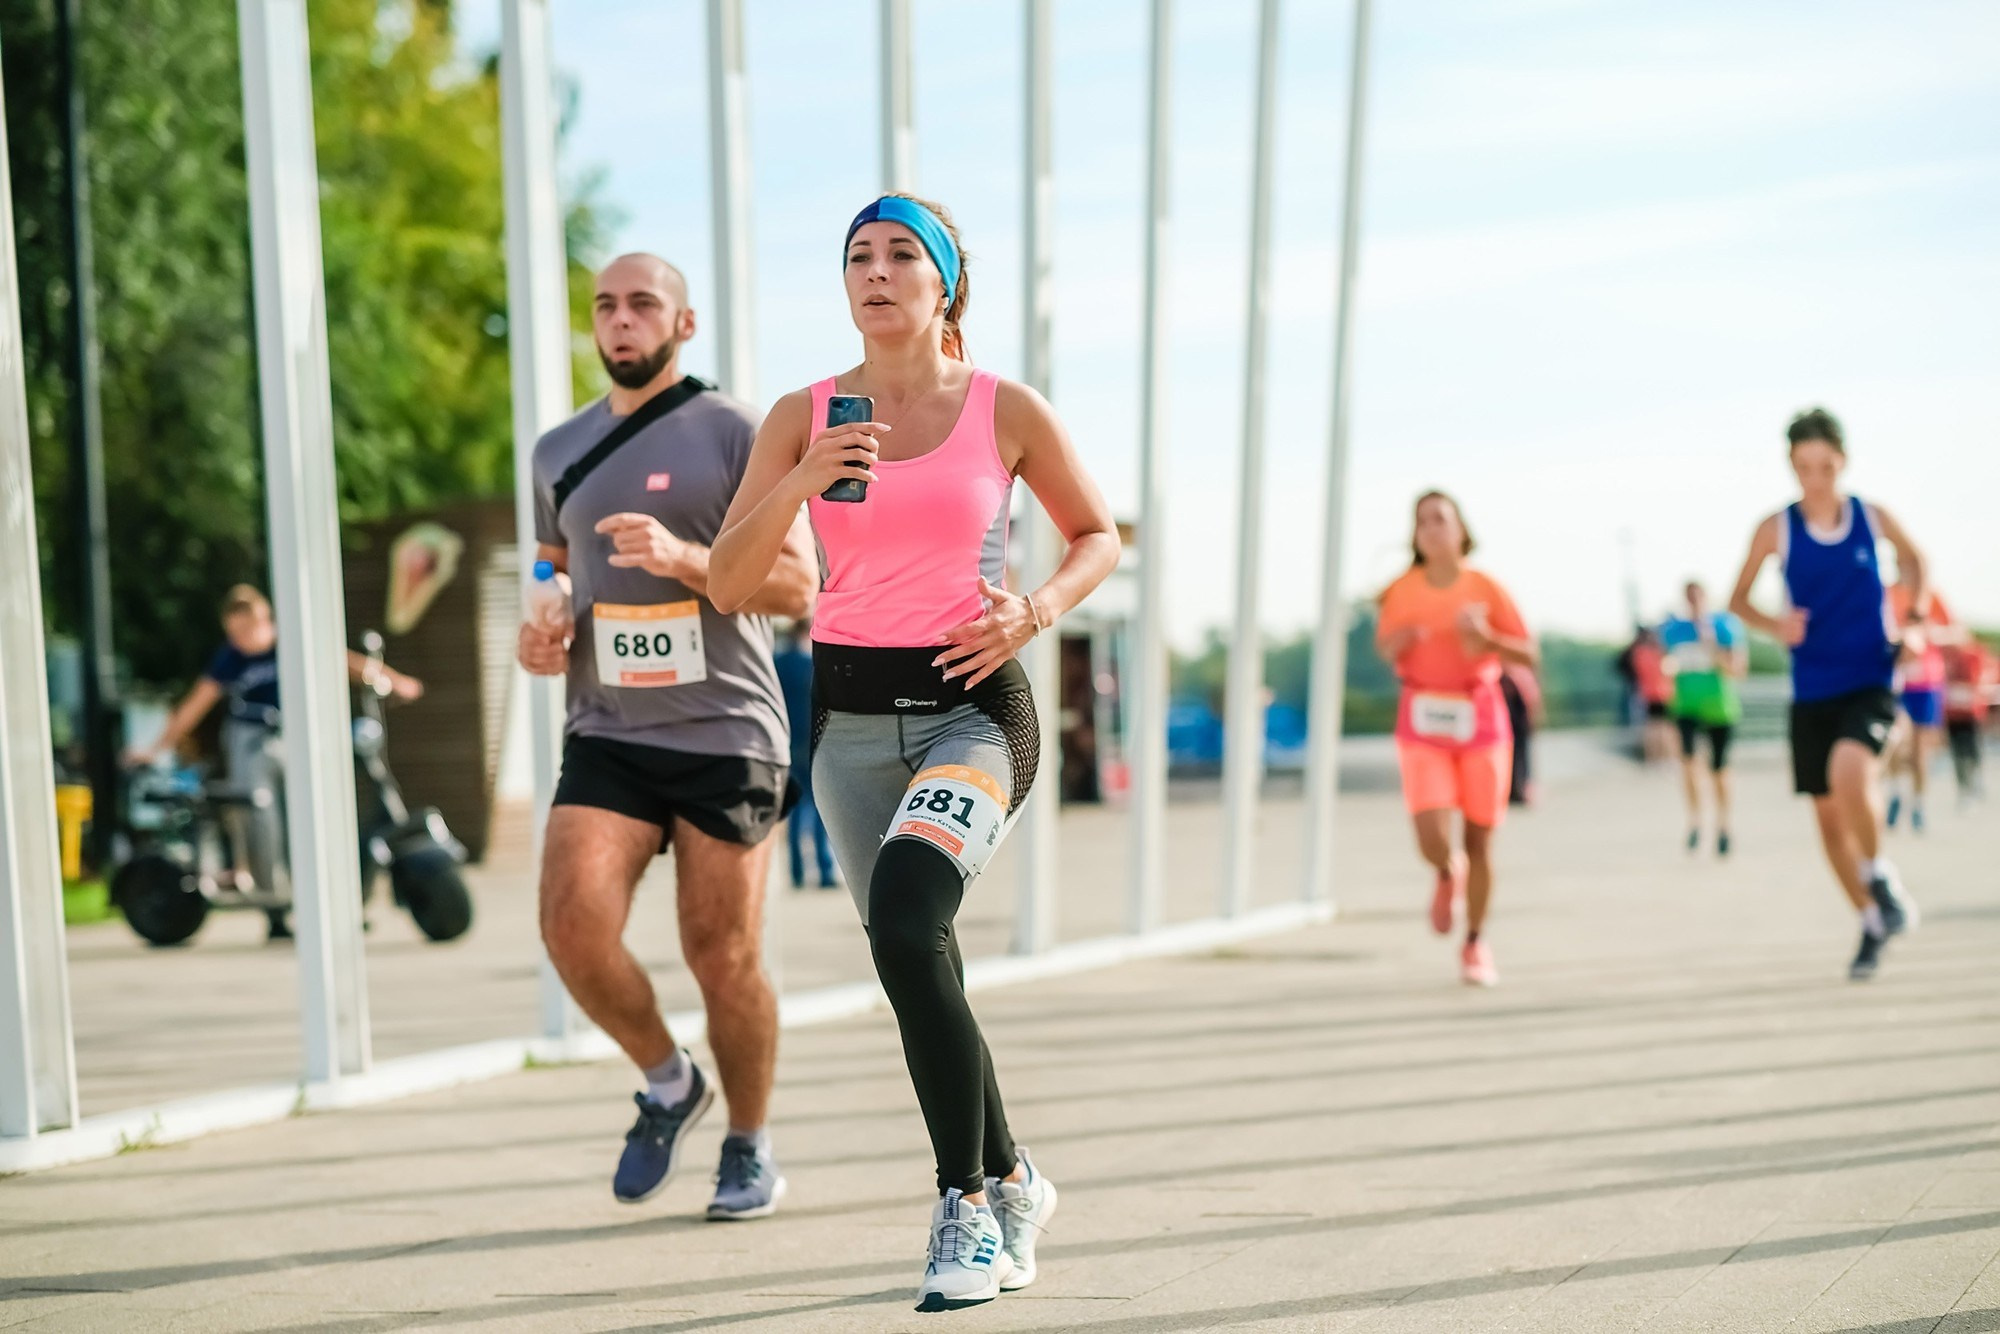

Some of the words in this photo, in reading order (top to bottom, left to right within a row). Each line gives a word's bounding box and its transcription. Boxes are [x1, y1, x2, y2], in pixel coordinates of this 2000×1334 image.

[613, 632, 672, 658] 680
[911, 699, 938, 707] Kalenji
[907, 788, 975, 829] 681
[937, 818, 966, 839] Катерина
